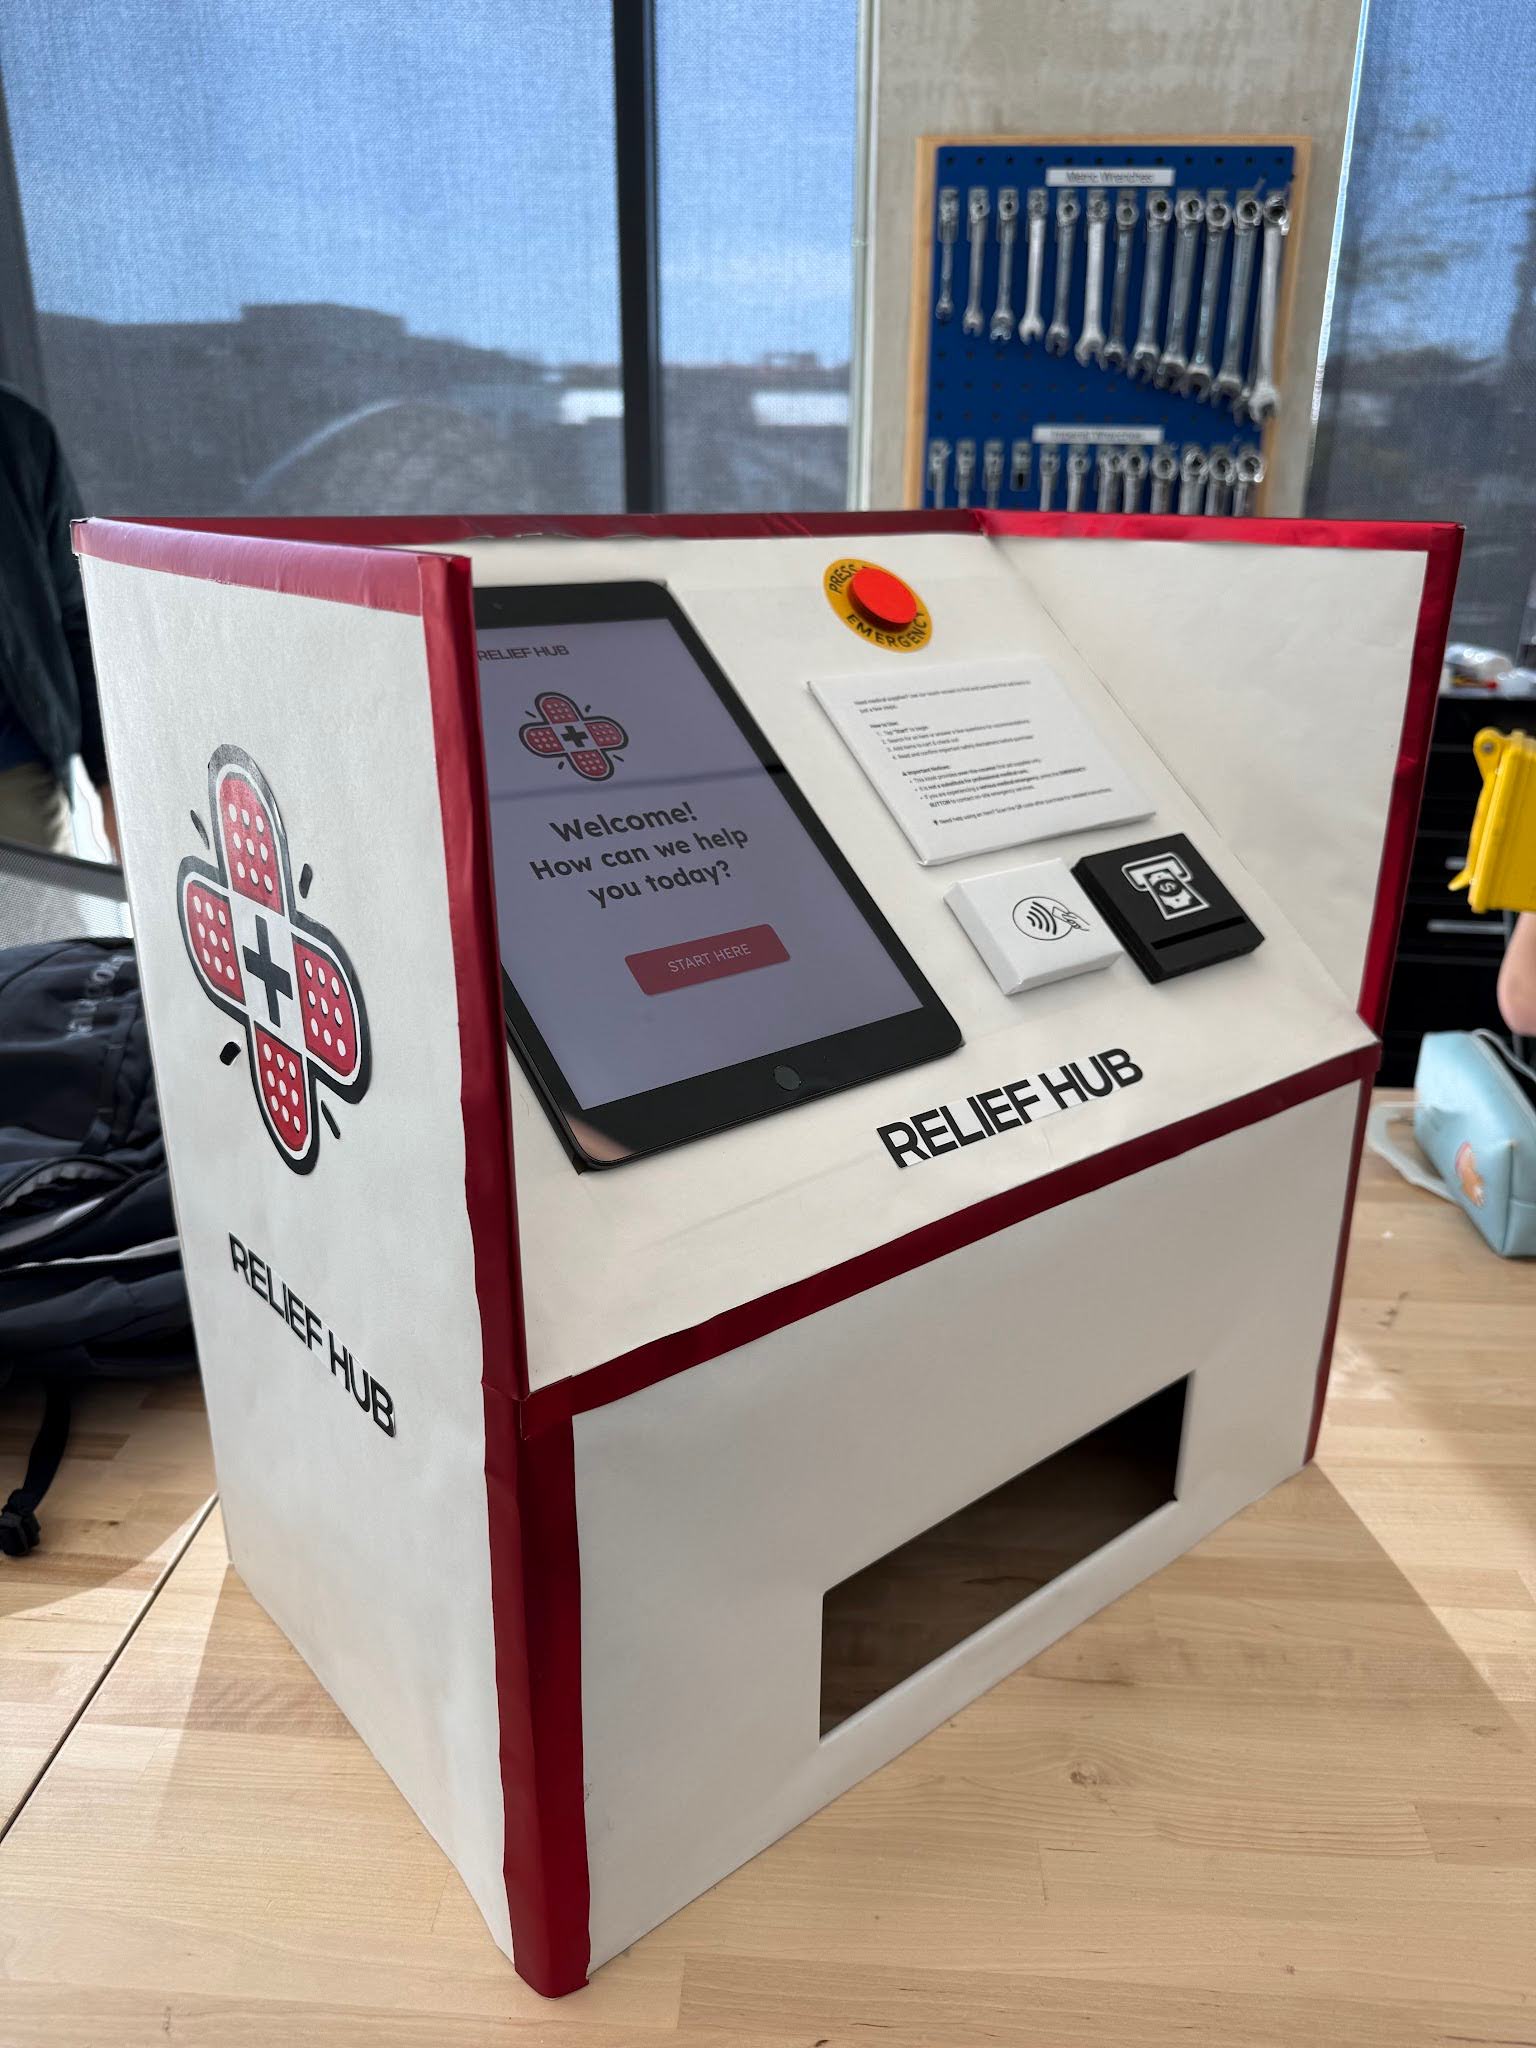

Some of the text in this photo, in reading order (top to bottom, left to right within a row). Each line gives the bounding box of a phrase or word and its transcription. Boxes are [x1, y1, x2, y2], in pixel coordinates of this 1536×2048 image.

[476, 644, 570, 661] RELIEF HUB
[549, 801, 698, 842] Welcome!
[529, 827, 749, 880] How can we help
[587, 859, 732, 909] you today?
[667, 943, 752, 973] START HERE
[876, 1048, 1144, 1169] RELIEF HUB
[228, 1231, 397, 1438] RELIEF HUB
